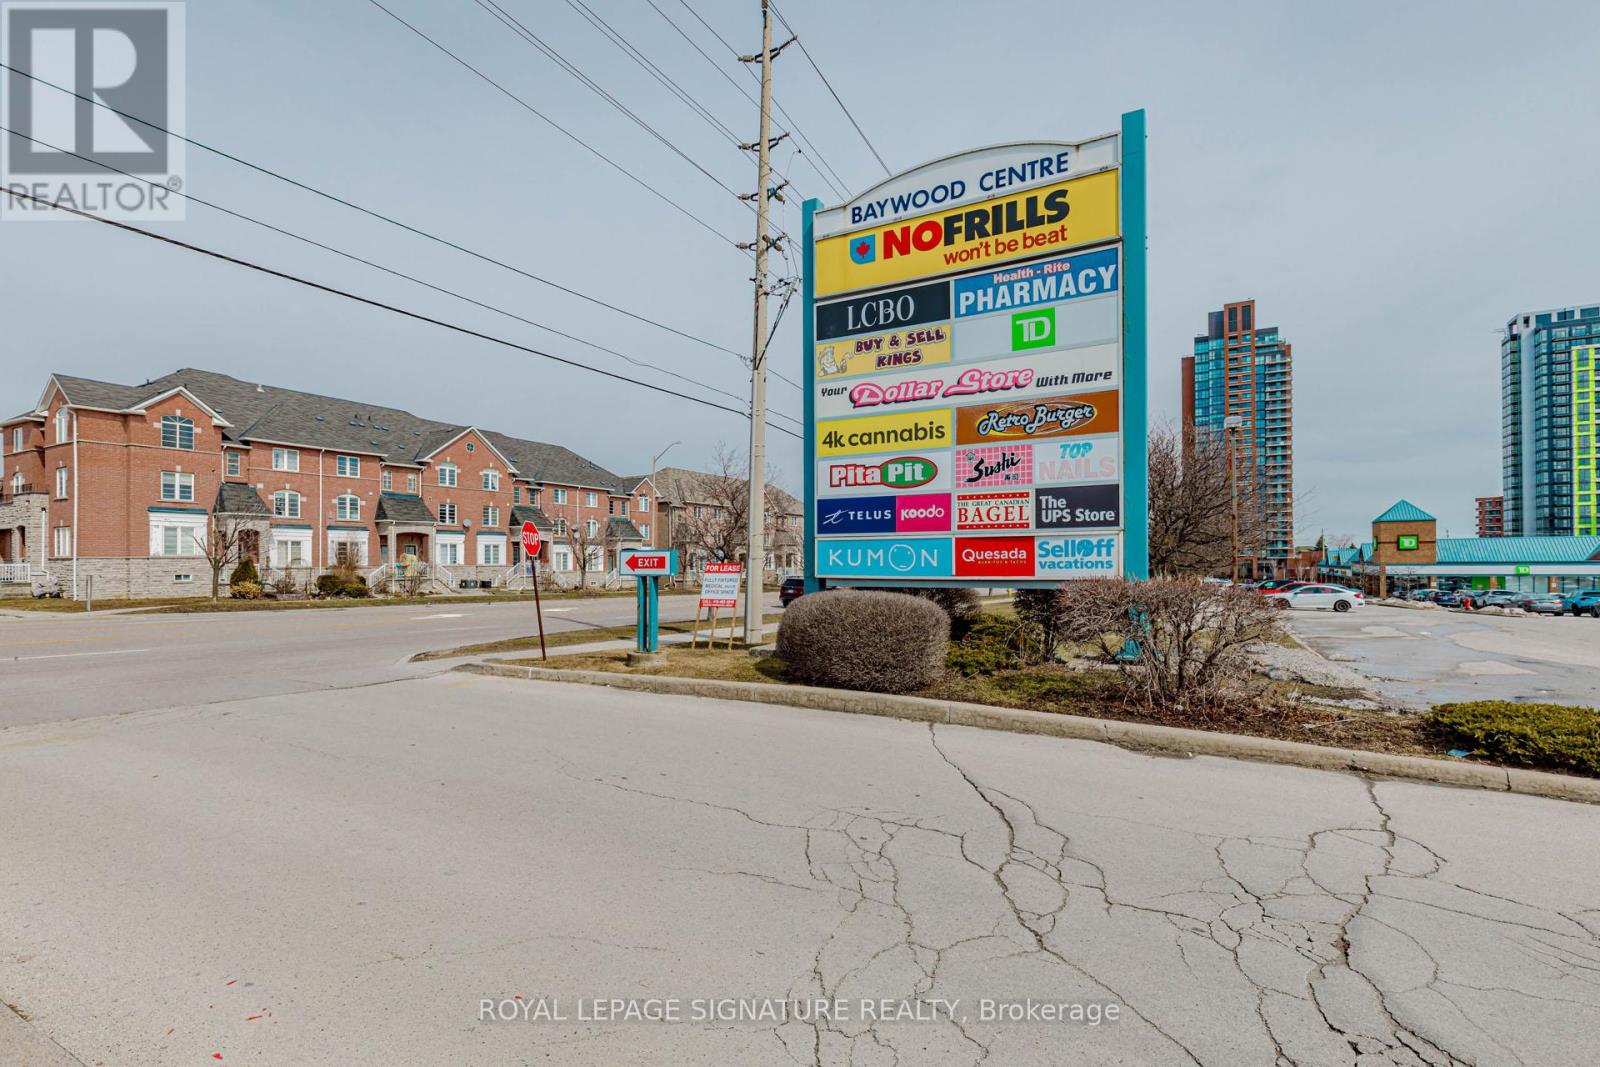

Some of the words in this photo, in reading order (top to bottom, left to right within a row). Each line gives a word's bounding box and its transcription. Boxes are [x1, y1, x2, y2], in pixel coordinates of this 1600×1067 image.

[851, 180, 966, 224] BAYWOOD
[979, 152, 1069, 191] CENTRE
[943, 241, 991, 265] won't
[994, 238, 1018, 255] be
[1022, 224, 1068, 249] beat
[993, 267, 1034, 284] Health
[1043, 261, 1071, 275] Rite
[959, 264, 1117, 315] PHARMACY
[847, 295, 915, 330] LCBO
[1016, 316, 1051, 342] TD
[855, 337, 883, 354] BUY
[889, 335, 900, 347] &
[906, 328, 945, 346] SELL
[876, 350, 922, 368] KINGS
[821, 386, 848, 397] Your
[849, 379, 944, 408] Dollar
[942, 368, 1034, 398] Store
[1036, 374, 1068, 388] With
[1071, 371, 1112, 384] More
[977, 410, 1031, 436] Retro
[1024, 404, 1094, 435] Burger
[822, 431, 846, 448] 4k
[847, 421, 946, 447] cannabis
[1060, 442, 1093, 459] TOP
[830, 464, 881, 488] Pita
[887, 462, 924, 482] Pit
[964, 451, 1021, 483] Sushi
[1039, 456, 1116, 481] NAILS
[994, 498, 1030, 506] CANADIAN
[1039, 495, 1066, 509] The
[848, 509, 892, 521] TELUS
[957, 505, 1030, 523] BAGEL
[1041, 509, 1071, 523] UPS
[1075, 508, 1115, 522] Store
[522, 531, 540, 546] STOP
[1037, 537, 1115, 559] SellOff
[637, 557, 659, 567] EXIT
[829, 543, 938, 572] KUMON
[961, 548, 1027, 562] Quesada
[1038, 559, 1114, 570] vacations
[705, 564, 719, 572] FOR
[719, 564, 741, 572] LEASE
